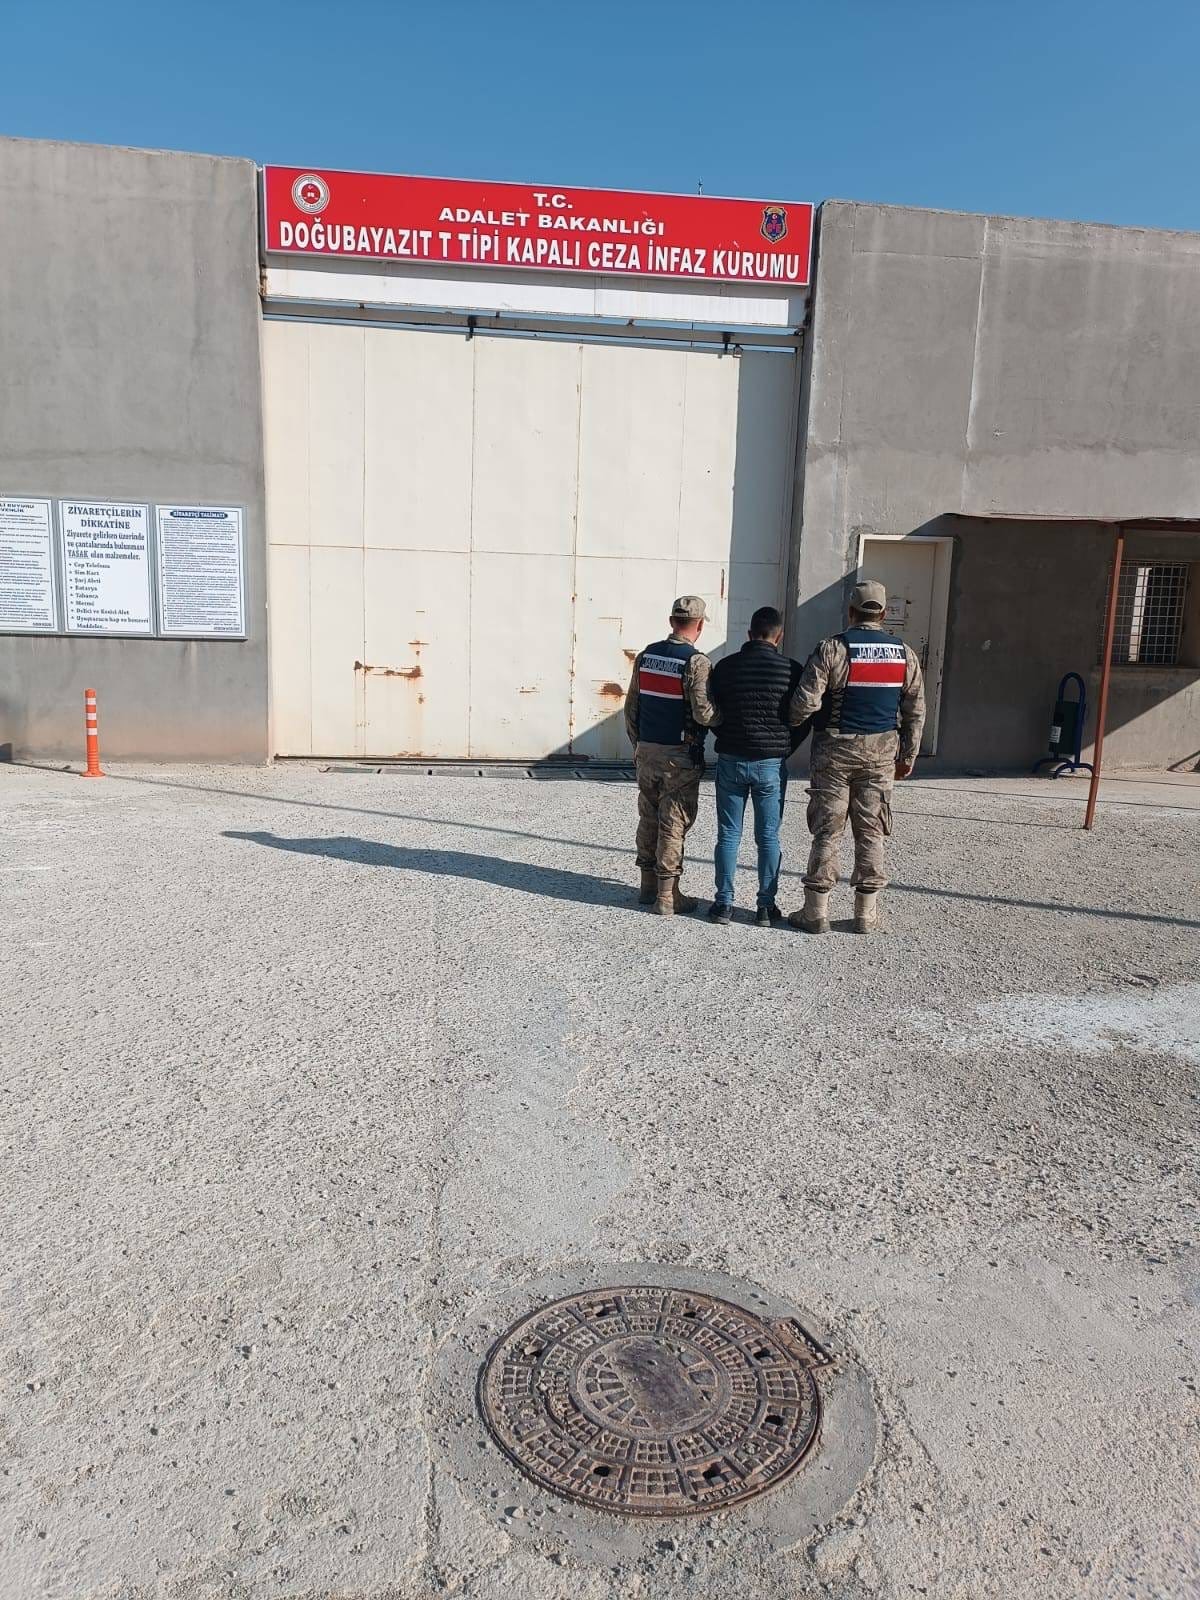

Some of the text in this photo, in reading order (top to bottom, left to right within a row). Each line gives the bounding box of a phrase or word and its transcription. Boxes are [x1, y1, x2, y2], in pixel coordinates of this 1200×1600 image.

[533, 193, 573, 209] T.C.
[439, 207, 665, 236] ADALET BAKANLIĞI
[279, 217, 800, 280] DOĞUBAYAZIT T TİPİ KAPALI CEZA İNFAZ KURUMU
[67, 505, 142, 519] ZİYARETÇİLERİN
[81, 517, 131, 529] DİKKATİNE
[856, 647, 902, 659] JANDARMA
